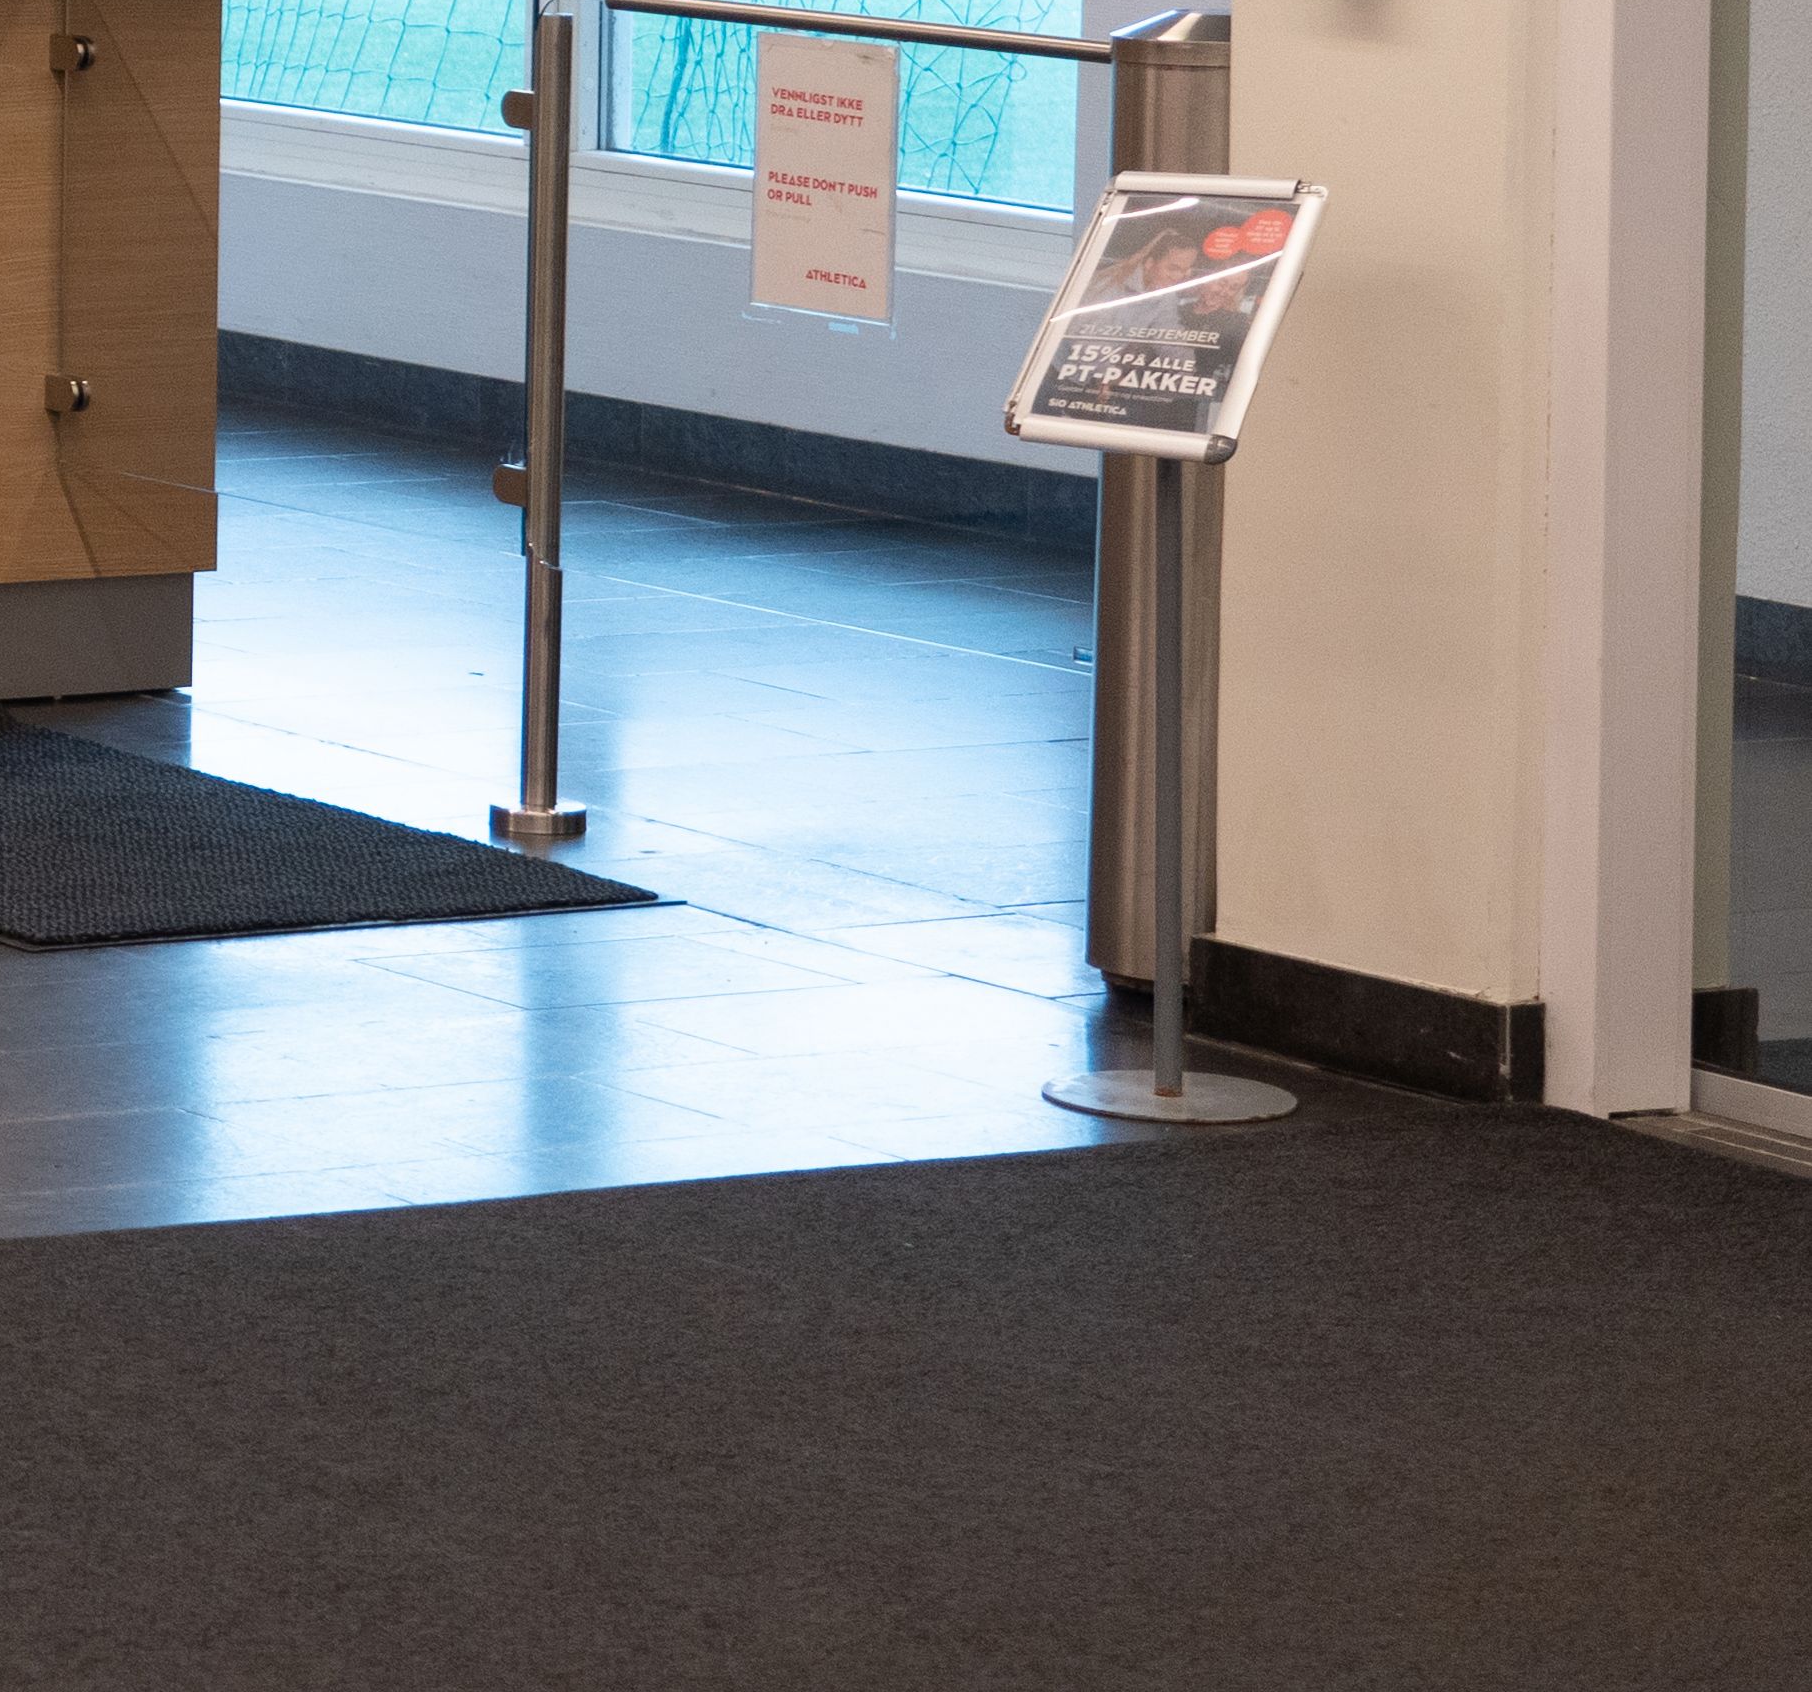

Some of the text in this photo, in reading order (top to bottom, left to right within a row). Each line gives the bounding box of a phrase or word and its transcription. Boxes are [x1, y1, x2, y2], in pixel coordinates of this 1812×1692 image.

[772, 86, 864, 111] VENNLIGST IKKE
[770, 103, 864, 128] DRA ELLER DYTT
[768, 170, 810, 188] PLEASE
[847, 184, 878, 199] PUSH
[767, 189, 813, 206] OR PULL
[805, 269, 867, 289] ATHLETICA
[1127, 327, 1220, 344] SEPTEMBER
[1067, 344, 1196, 372] 15% PÅ ALLE
[1057, 364, 1218, 397] PT-PAKKER
[1068, 400, 1127, 416] ATHLETICA
